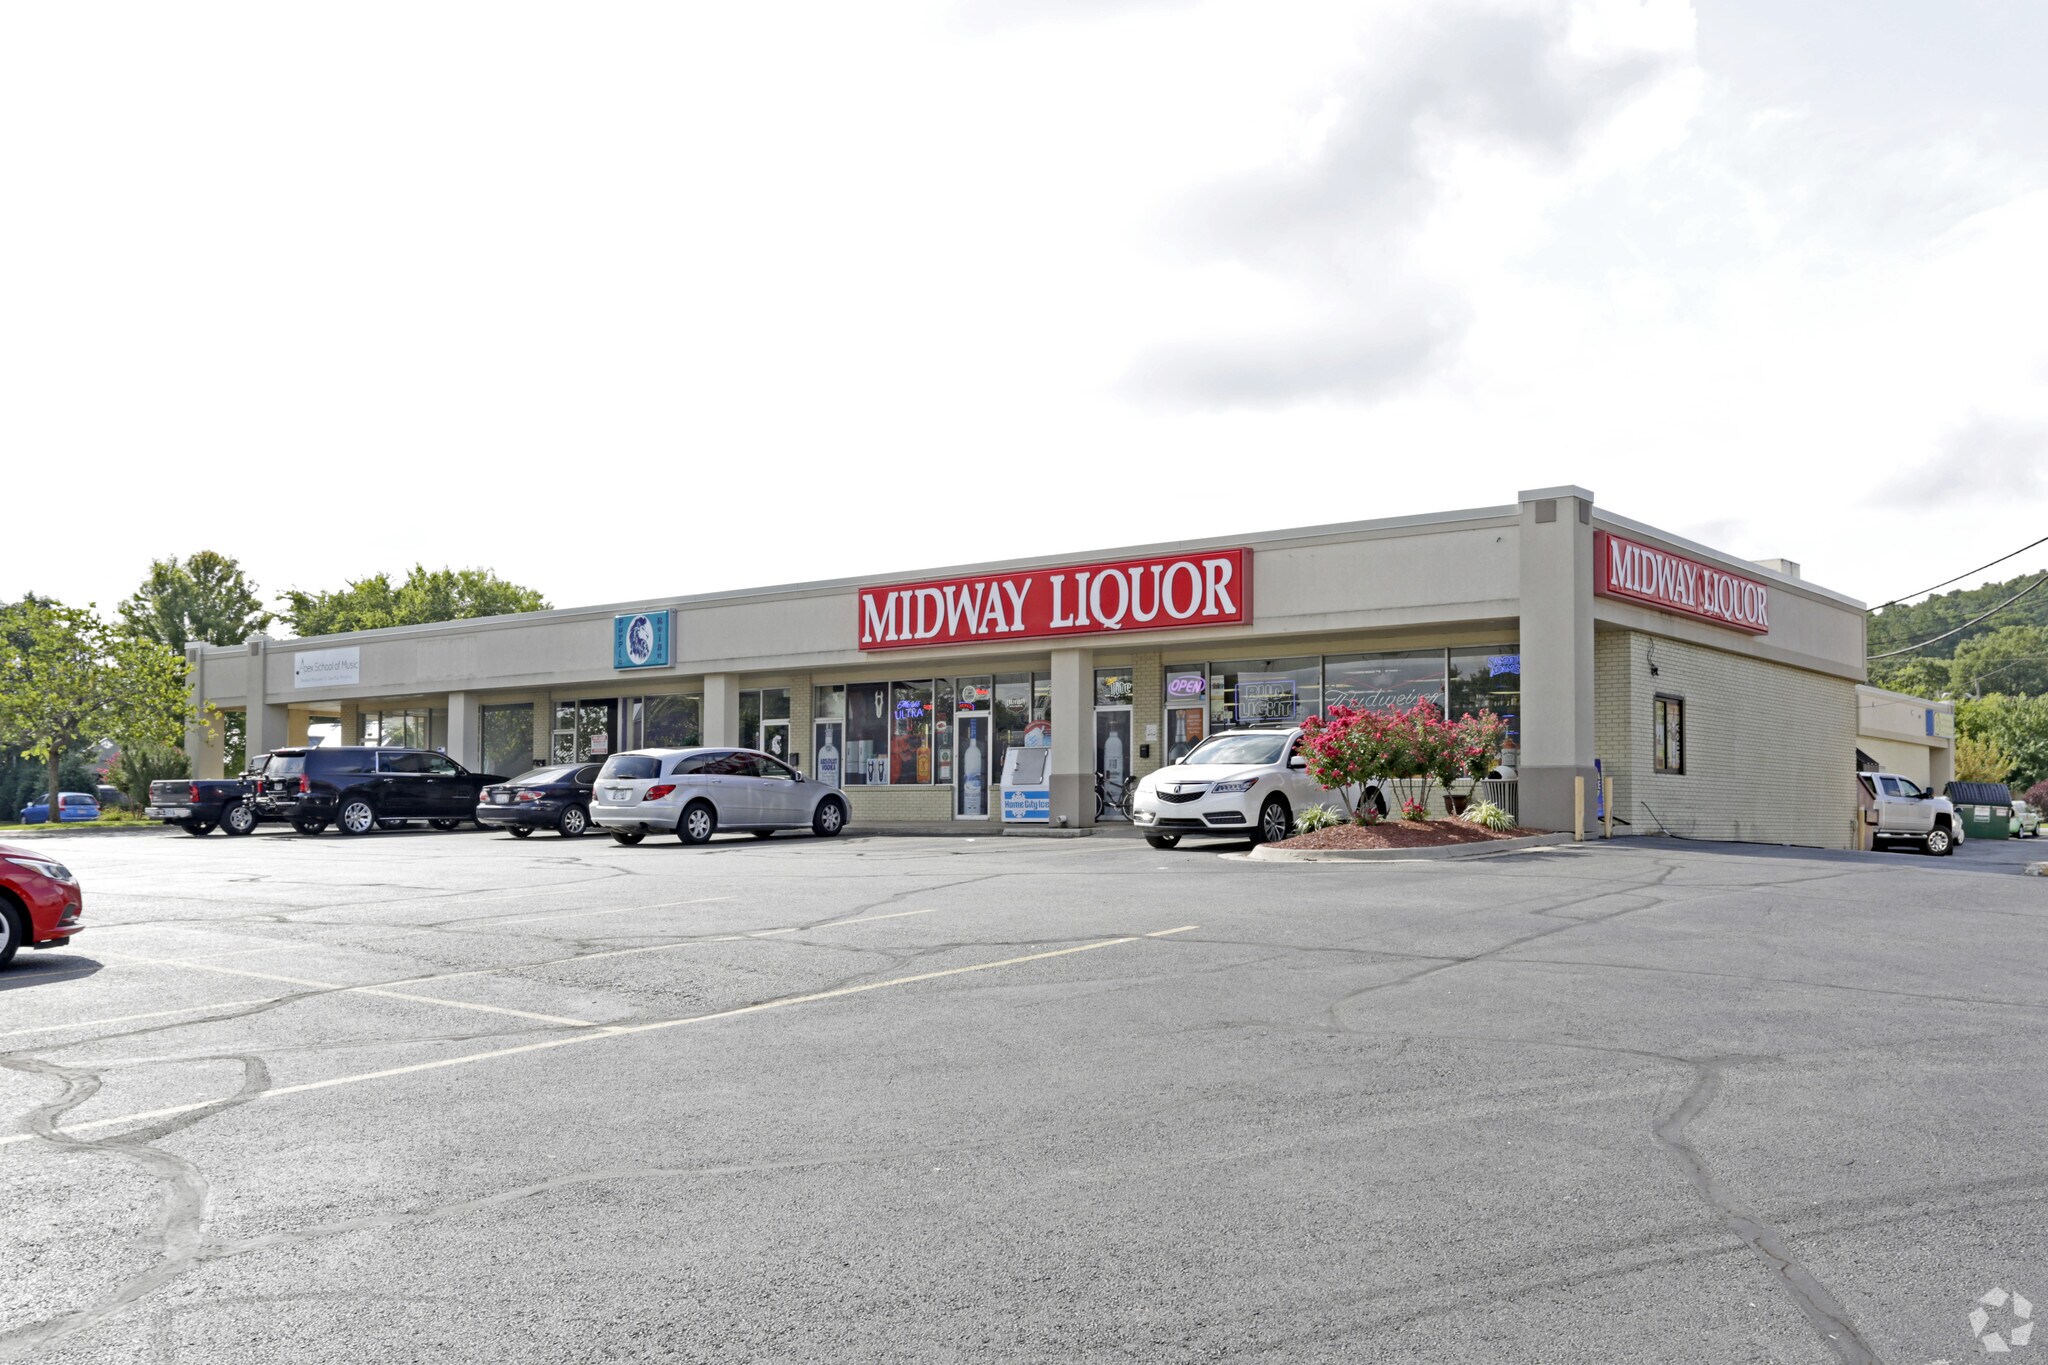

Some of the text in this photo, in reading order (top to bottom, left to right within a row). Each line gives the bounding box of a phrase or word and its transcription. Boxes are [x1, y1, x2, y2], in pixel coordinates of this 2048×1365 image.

[1610, 540, 1768, 626] MIDWAY LIQUOR
[862, 558, 1237, 643] MIDWAY LIQUOR
[314, 661, 334, 672] School
[335, 661, 341, 670] of
[341, 660, 359, 670] Music
[1170, 679, 1202, 694] OPEN
[1246, 684, 1284, 700] BUD
[894, 709, 924, 719] ULTRA
[1239, 701, 1292, 718] LIGHT
[1004, 800, 1024, 808] Home
[1024, 800, 1038, 810] City
